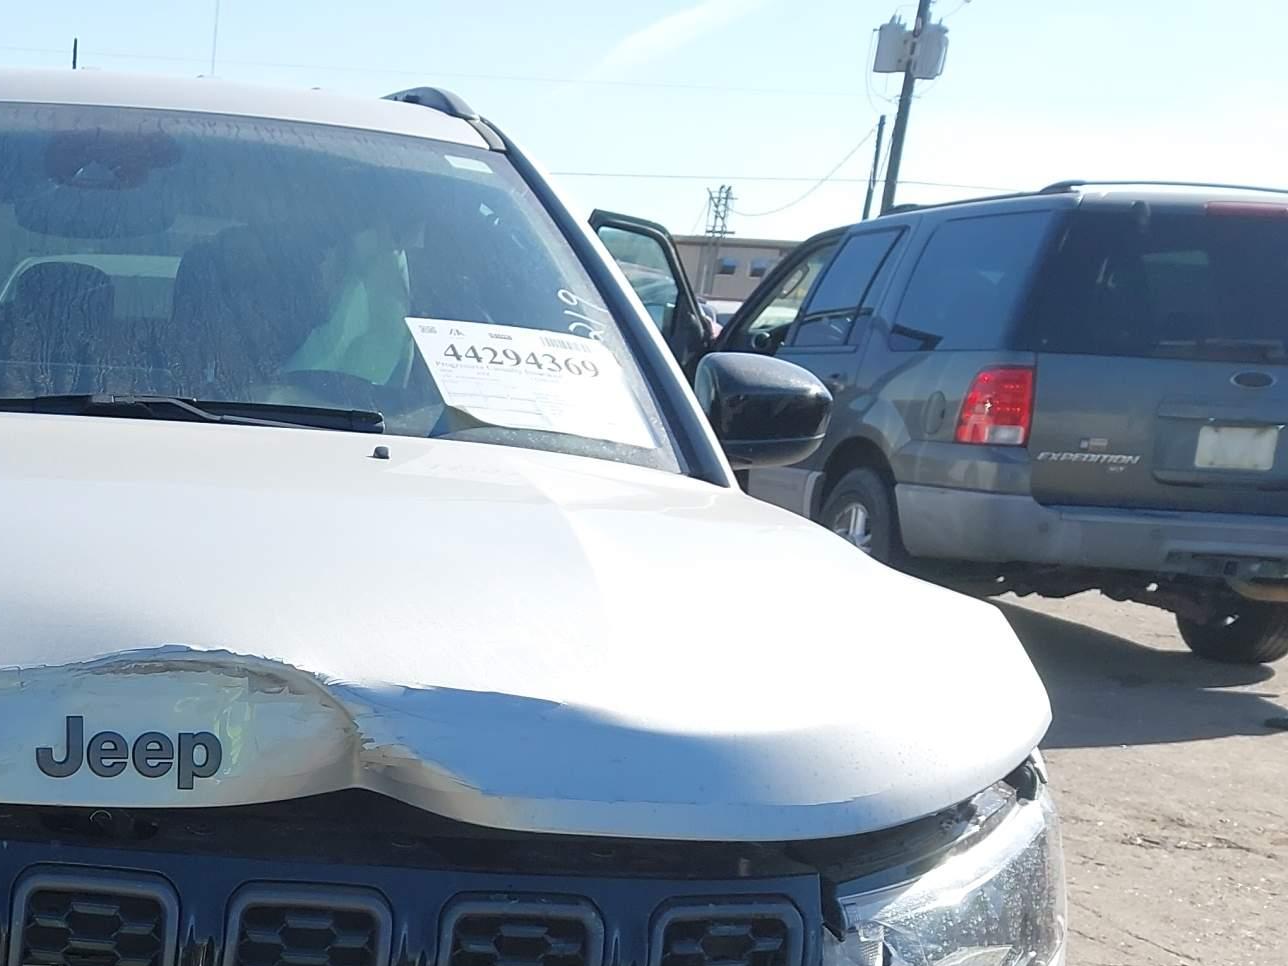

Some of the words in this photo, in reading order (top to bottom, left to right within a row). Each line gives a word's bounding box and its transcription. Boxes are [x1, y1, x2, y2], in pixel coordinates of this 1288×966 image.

[443, 343, 600, 378] 44294369
[1036, 451, 1141, 465] EXPEDITION
[35, 715, 223, 790] Jeep
